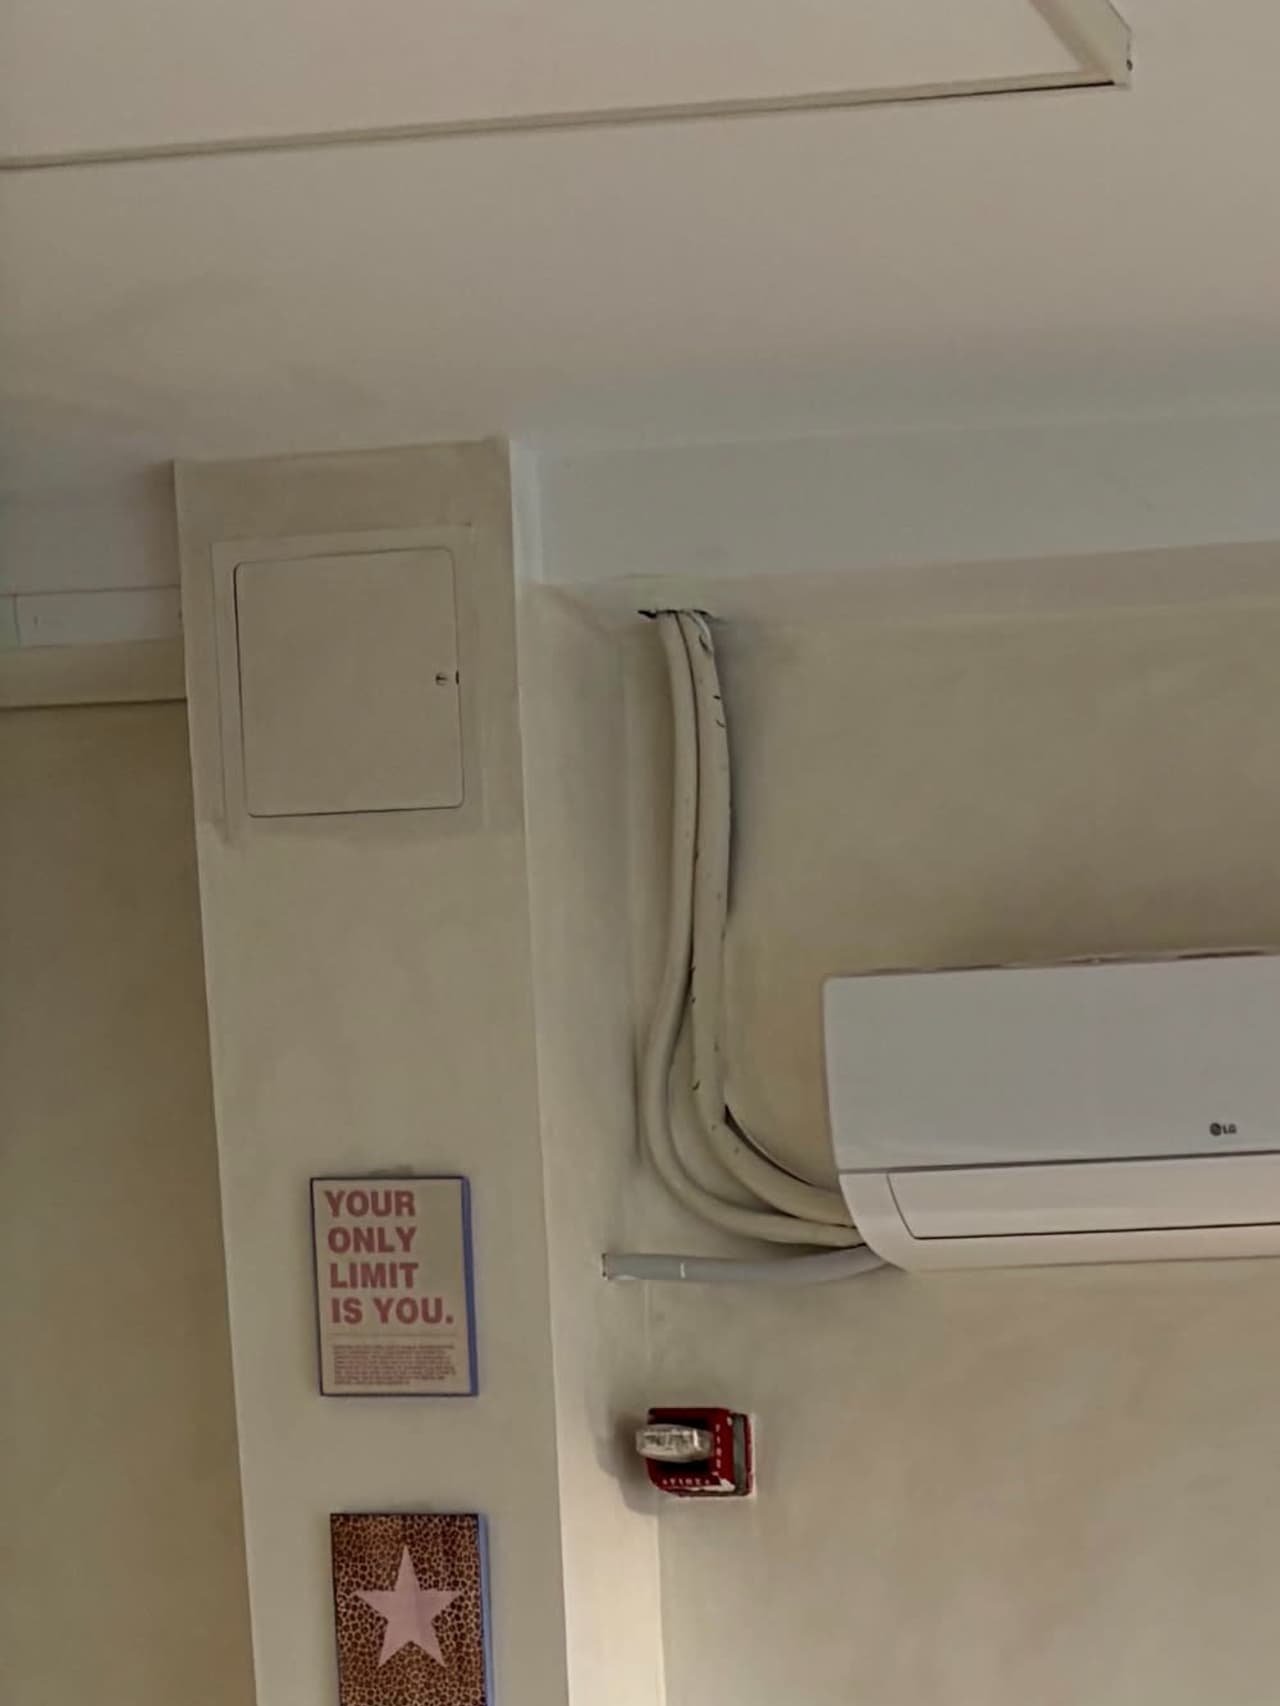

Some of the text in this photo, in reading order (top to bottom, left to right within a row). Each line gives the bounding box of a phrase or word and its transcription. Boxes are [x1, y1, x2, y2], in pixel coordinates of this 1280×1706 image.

[324, 1190, 416, 1217] YOUR
[327, 1226, 417, 1253] ONLY
[329, 1262, 419, 1289] LIMIT
[331, 1297, 454, 1324] IS YOU.
